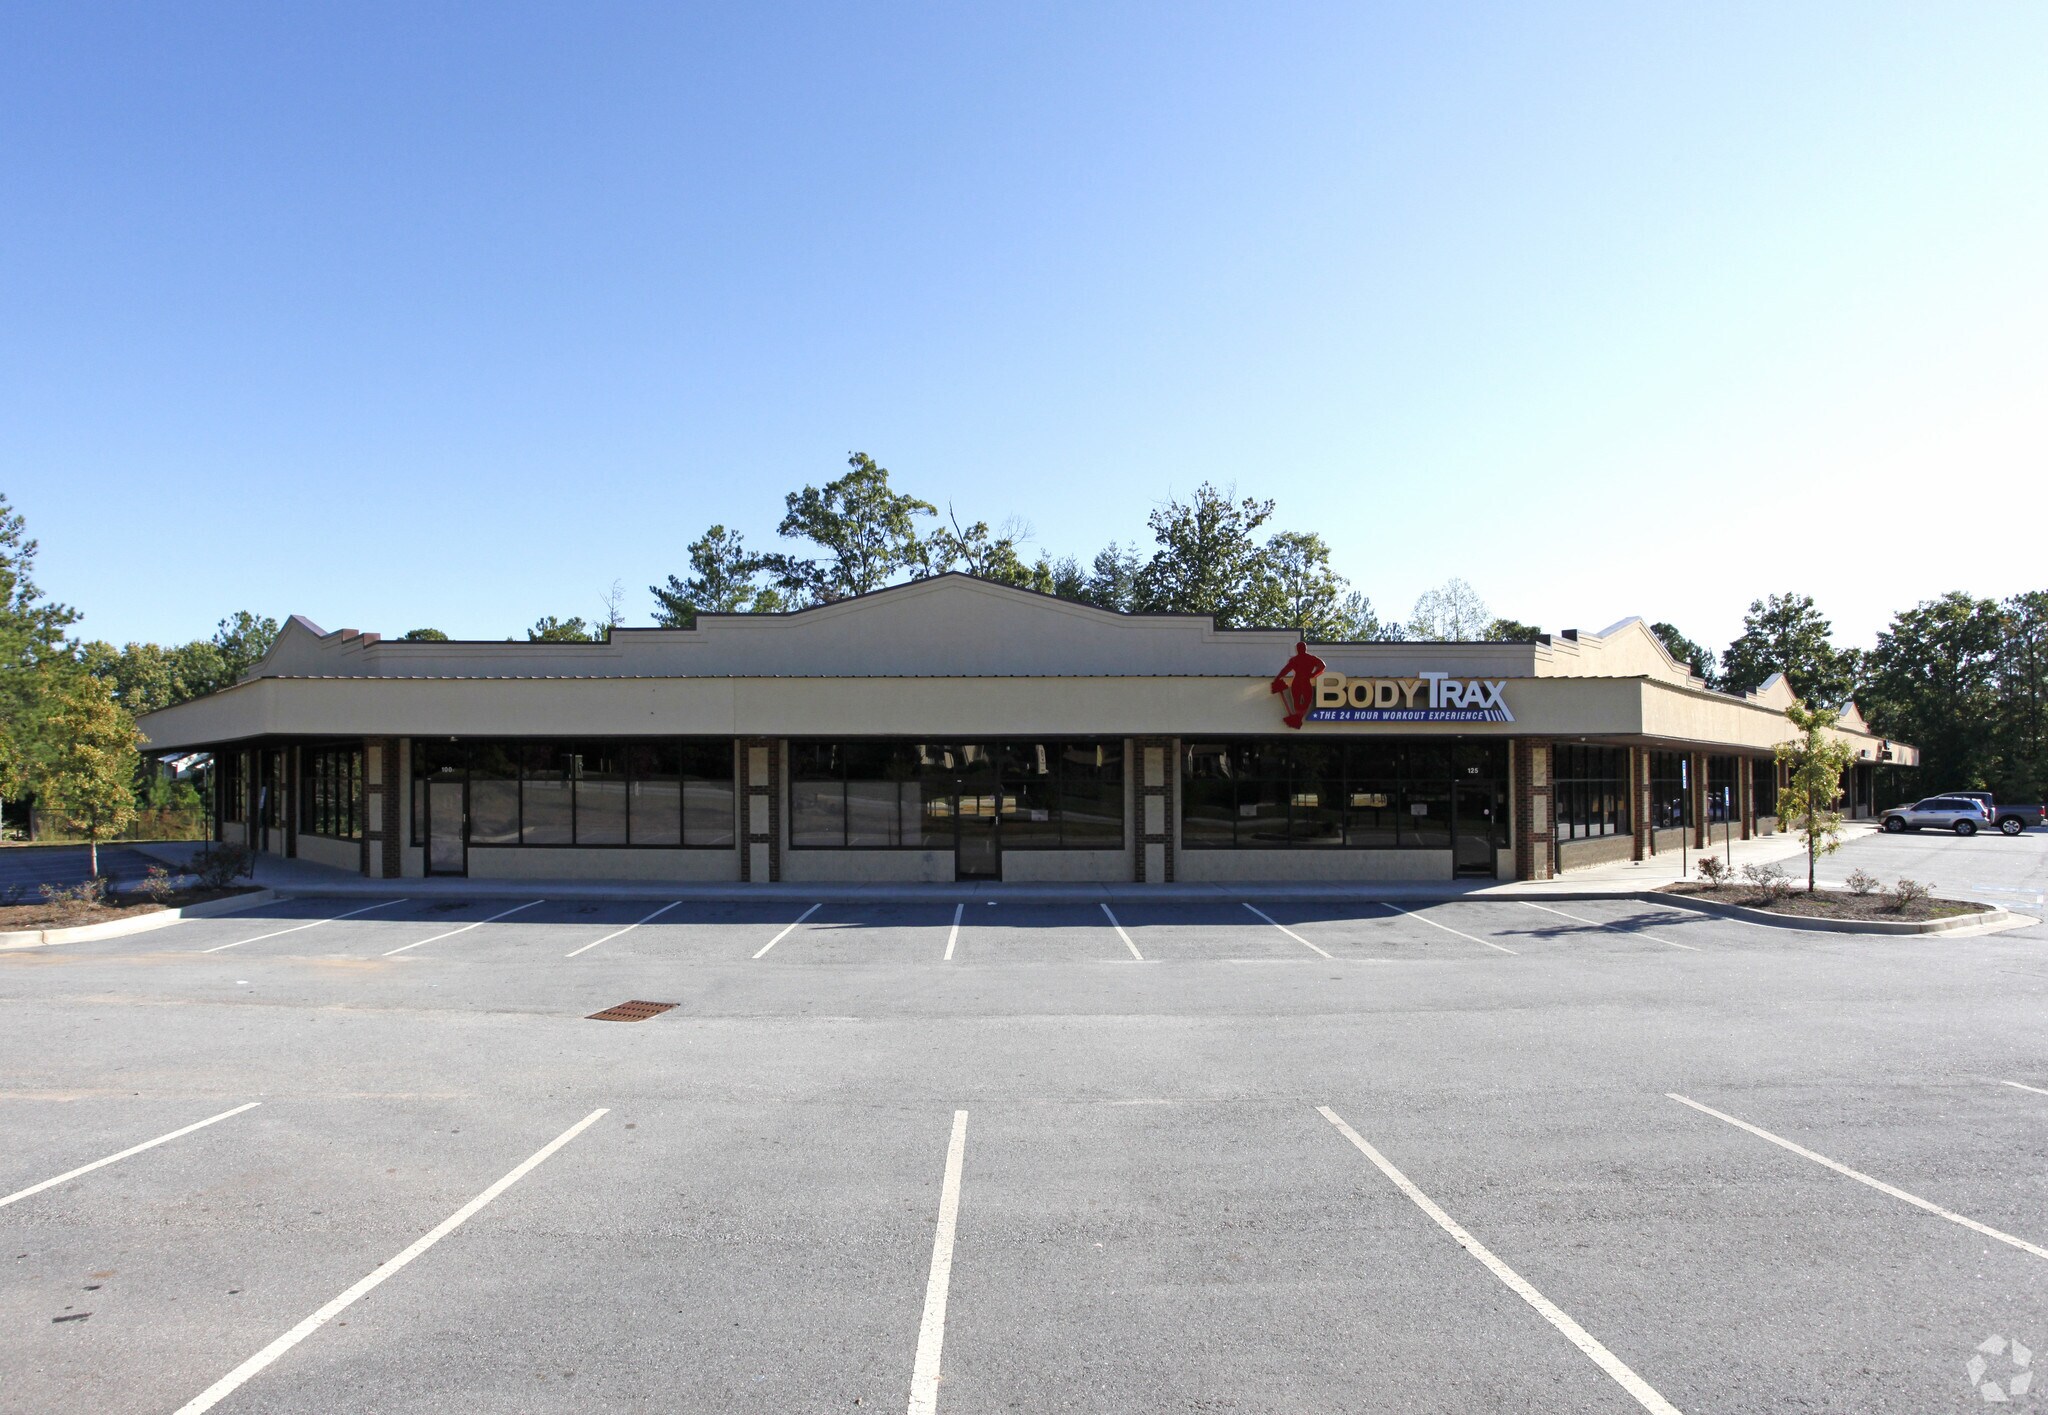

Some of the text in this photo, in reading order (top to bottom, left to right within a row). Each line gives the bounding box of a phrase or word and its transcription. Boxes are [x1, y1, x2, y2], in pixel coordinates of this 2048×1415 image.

[1319, 711, 1484, 720] THE 24 HOUR WORKOUT EXPERIENCE
